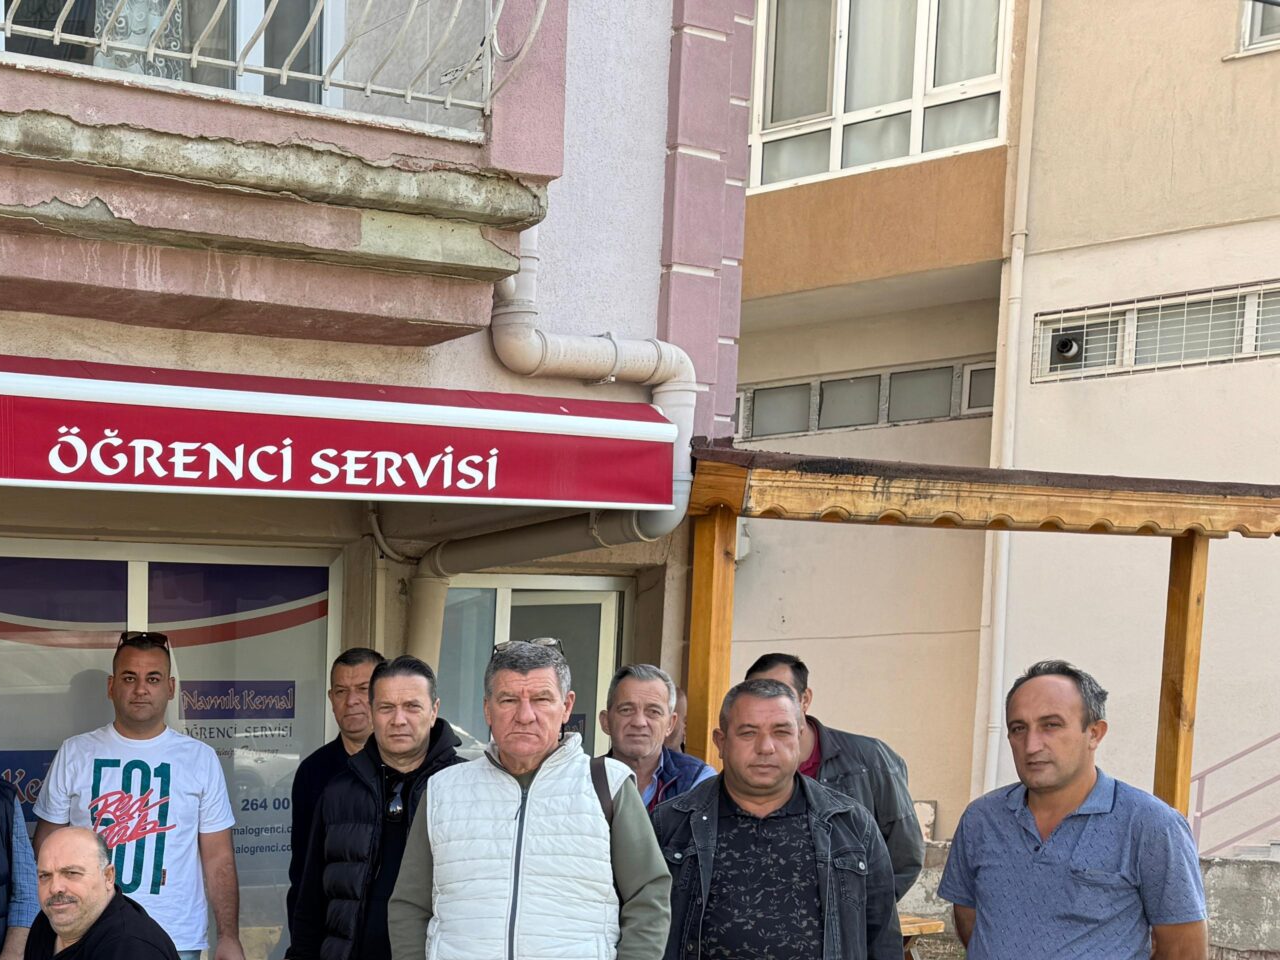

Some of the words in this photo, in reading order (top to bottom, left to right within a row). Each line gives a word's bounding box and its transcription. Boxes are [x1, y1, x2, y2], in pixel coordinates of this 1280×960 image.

[48, 425, 293, 482] ÖĞRENCİ
[310, 444, 498, 491] SERVİSİ
[242, 687, 293, 710] Kemal
[244, 722, 293, 739] SERVİSİ
[88, 788, 170, 834] Red
[241, 798, 268, 811] 264
[273, 797, 290, 810] 00
